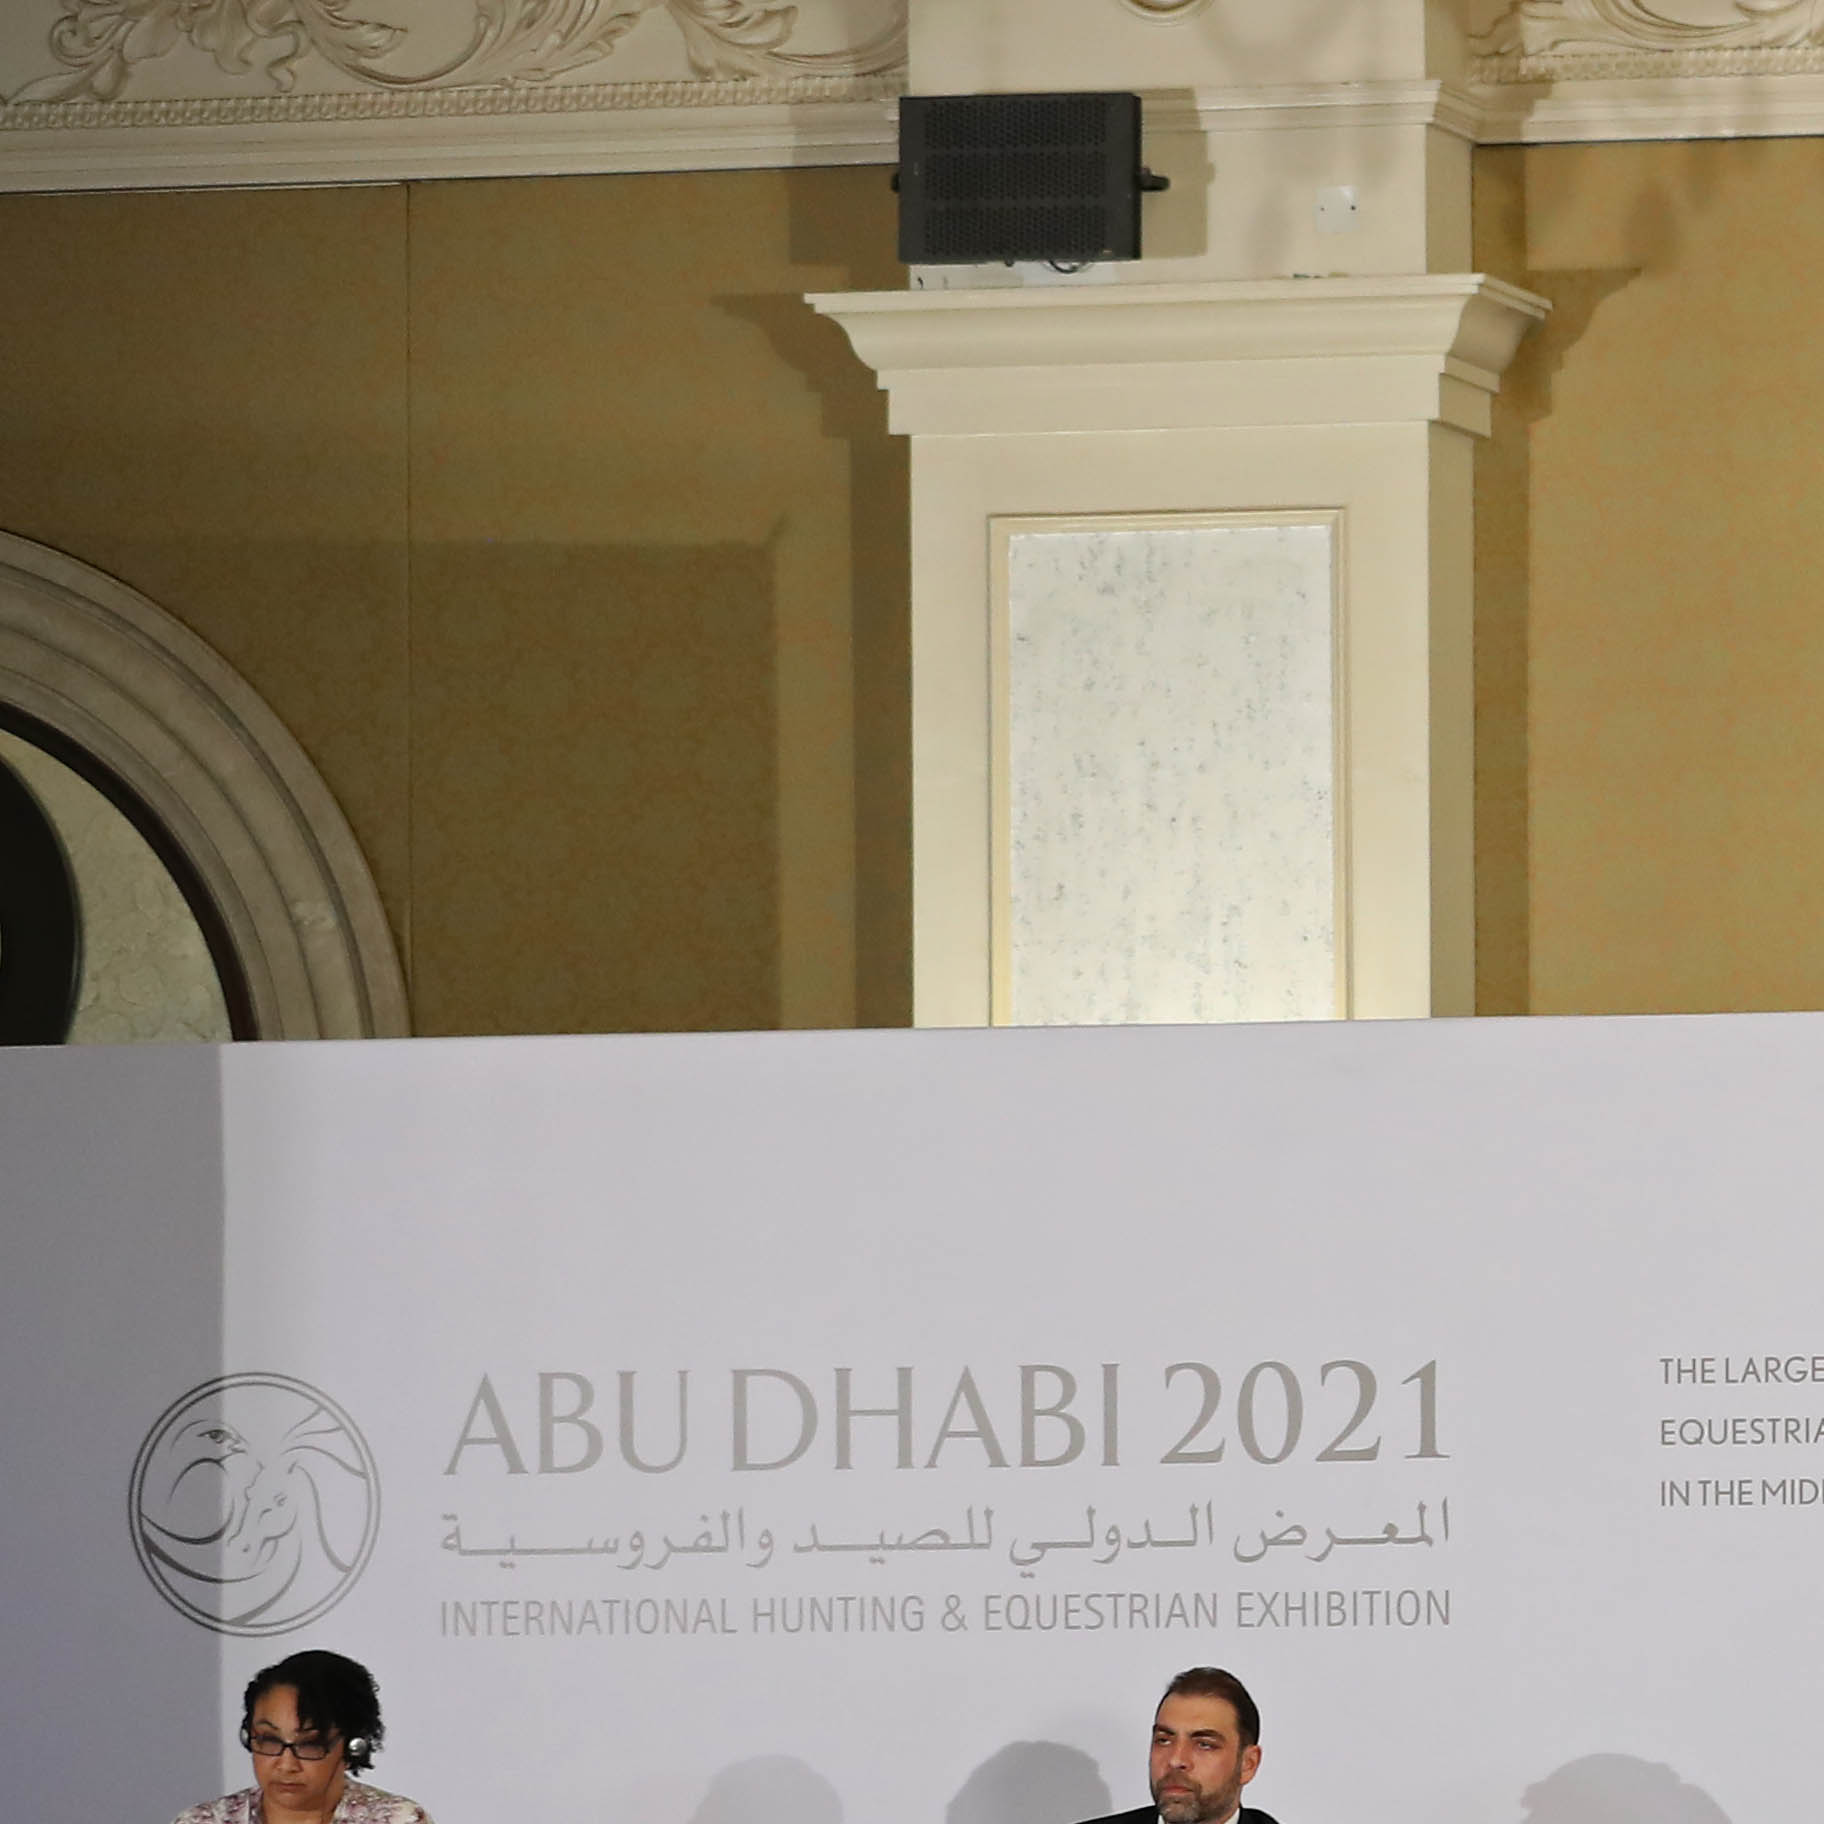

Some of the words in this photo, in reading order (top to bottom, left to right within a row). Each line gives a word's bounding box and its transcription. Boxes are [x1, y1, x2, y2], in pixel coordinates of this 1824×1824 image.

[1659, 1357, 1716, 1385] THE
[442, 1369, 689, 1476] ABU
[730, 1363, 1121, 1473] DHABI
[1159, 1359, 1451, 1465] 2021
[1661, 1480, 1690, 1507] IN
[1697, 1479, 1754, 1507] THE
[439, 1507, 774, 1571] والفروسية
[792, 1505, 995, 1565] للصيد
[1009, 1499, 1214, 1579] الدولي
[1233, 1496, 1449, 1564] المعرض
[440, 1597, 739, 1637] INTERNATIONAL
[752, 1595, 924, 1634] HUNTING
[940, 1593, 969, 1633] &
[984, 1592, 1218, 1631] EQUESTRIAN
[1237, 1589, 1450, 1628] EXHIBITION
